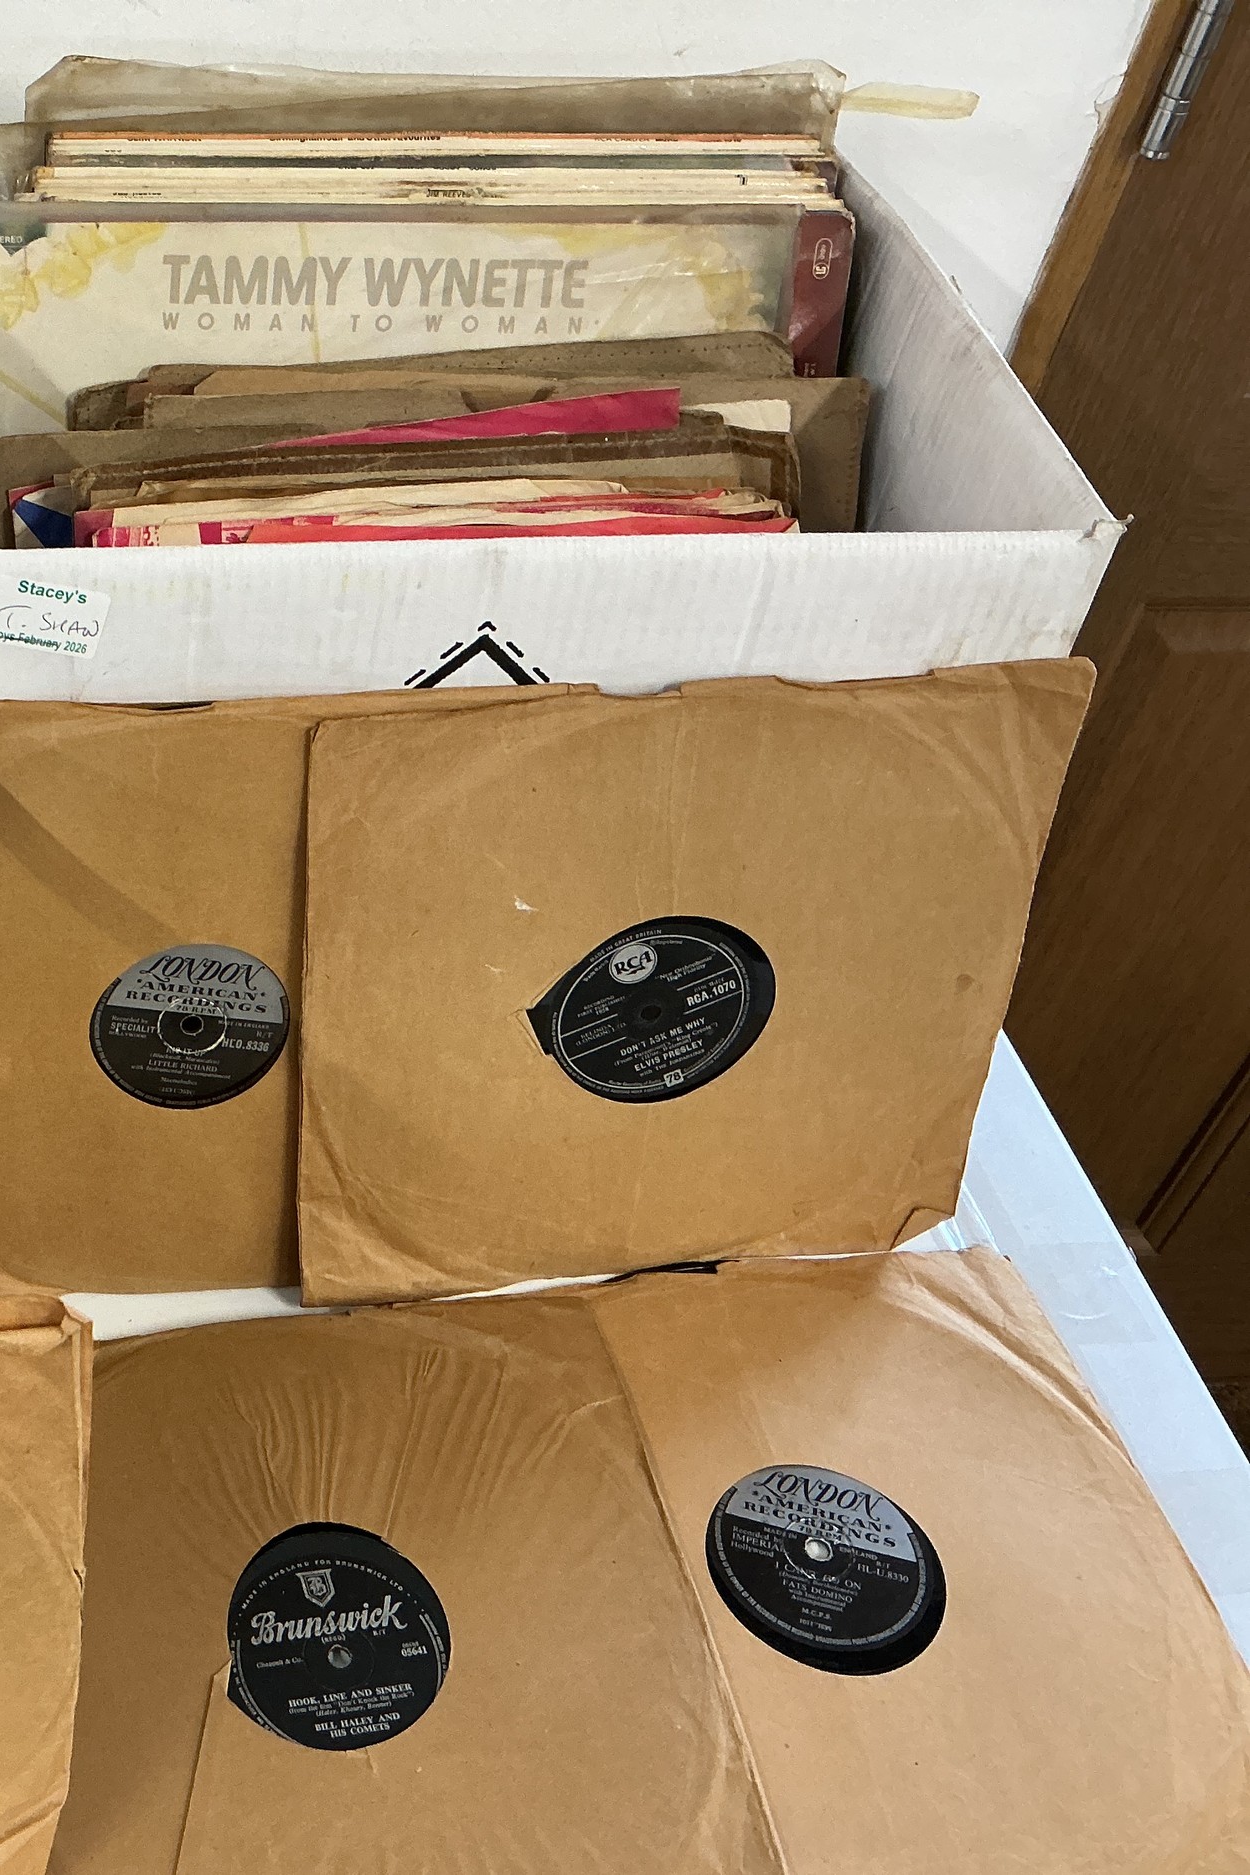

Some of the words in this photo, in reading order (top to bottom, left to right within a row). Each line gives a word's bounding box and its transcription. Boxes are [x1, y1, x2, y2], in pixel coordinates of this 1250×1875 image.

[162, 254, 352, 306] TAMMY
[363, 257, 589, 308] WYNETTE
[162, 311, 317, 333] WOMAN
[350, 313, 393, 333] TO
[425, 314, 584, 335] WOMAN
[17, 580, 88, 605] Stacey's
[18, 632, 62, 652] February
[63, 640, 88, 654] 2026
[590, 950, 606, 963] MADE
[614, 935, 634, 947] GREAT
[139, 955, 266, 991] LONDON
[614, 950, 653, 976] RCA
[125, 990, 267, 1014] RECORDINGS
[140, 981, 260, 1001] AMERICAN
[686, 979, 737, 1007] RCA.1070
[620, 1040, 648, 1057] DON'T
[649, 1032, 668, 1046] ASK
[669, 1026, 684, 1038] ME
[685, 1017, 706, 1031] WHY
[148, 1059, 179, 1068] LITTLE
[180, 1062, 218, 1072] RICHARD
[634, 1056, 661, 1072] ELVIS
[662, 1039, 704, 1061] PRESLEY
[665, 1071, 682, 1084] 78
[753, 1470, 883, 1521] LONDON
[743, 1500, 898, 1549] RECORDINGS
[758, 1493, 882, 1533] AMERICAN
[241, 1589, 259, 1610] MADE
[258, 1579, 268, 1589] IN
[268, 1561, 310, 1581] ENGLAND
[335, 1559, 388, 1581] BRUNSWICK
[388, 1579, 405, 1592] LTD
[782, 1579, 807, 1591] FATS
[811, 1586, 853, 1603] DOMINO
[844, 1579, 862, 1591] ON
[250, 1595, 408, 1646] Brunswick
[400, 1645, 428, 1658] 05641
[288, 1696, 321, 1709] HOOK,
[323, 1692, 348, 1703] LINE
[350, 1688, 373, 1699] AND
[375, 1683, 413, 1695] SINKER
[314, 1720, 338, 1732] BILL
[340, 1716, 374, 1729] HALEY
[378, 1711, 401, 1722] AND
[330, 1728, 347, 1739] HIS
[350, 1722, 391, 1736] COMETS
